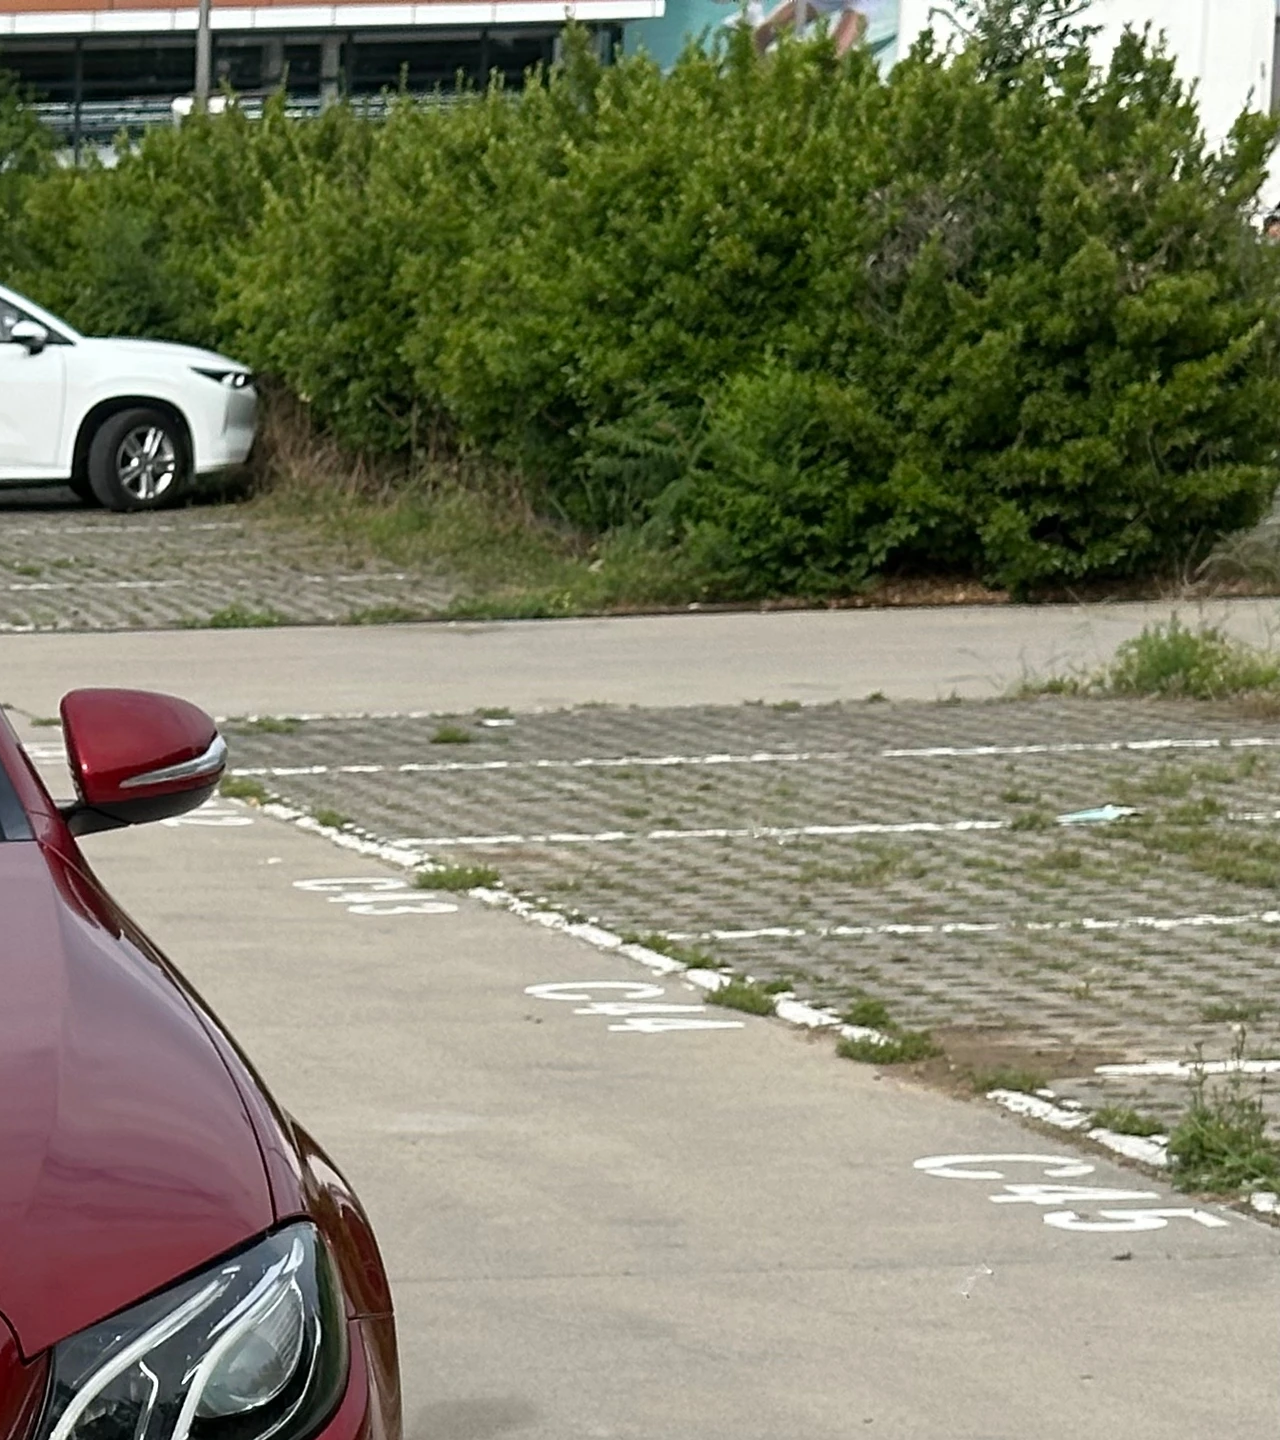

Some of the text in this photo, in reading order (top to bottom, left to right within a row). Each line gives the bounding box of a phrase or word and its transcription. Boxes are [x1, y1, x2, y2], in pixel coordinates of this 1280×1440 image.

[293, 877, 458, 915] C43
[525, 981, 744, 1032] C44
[913, 1154, 1230, 1232] C45
